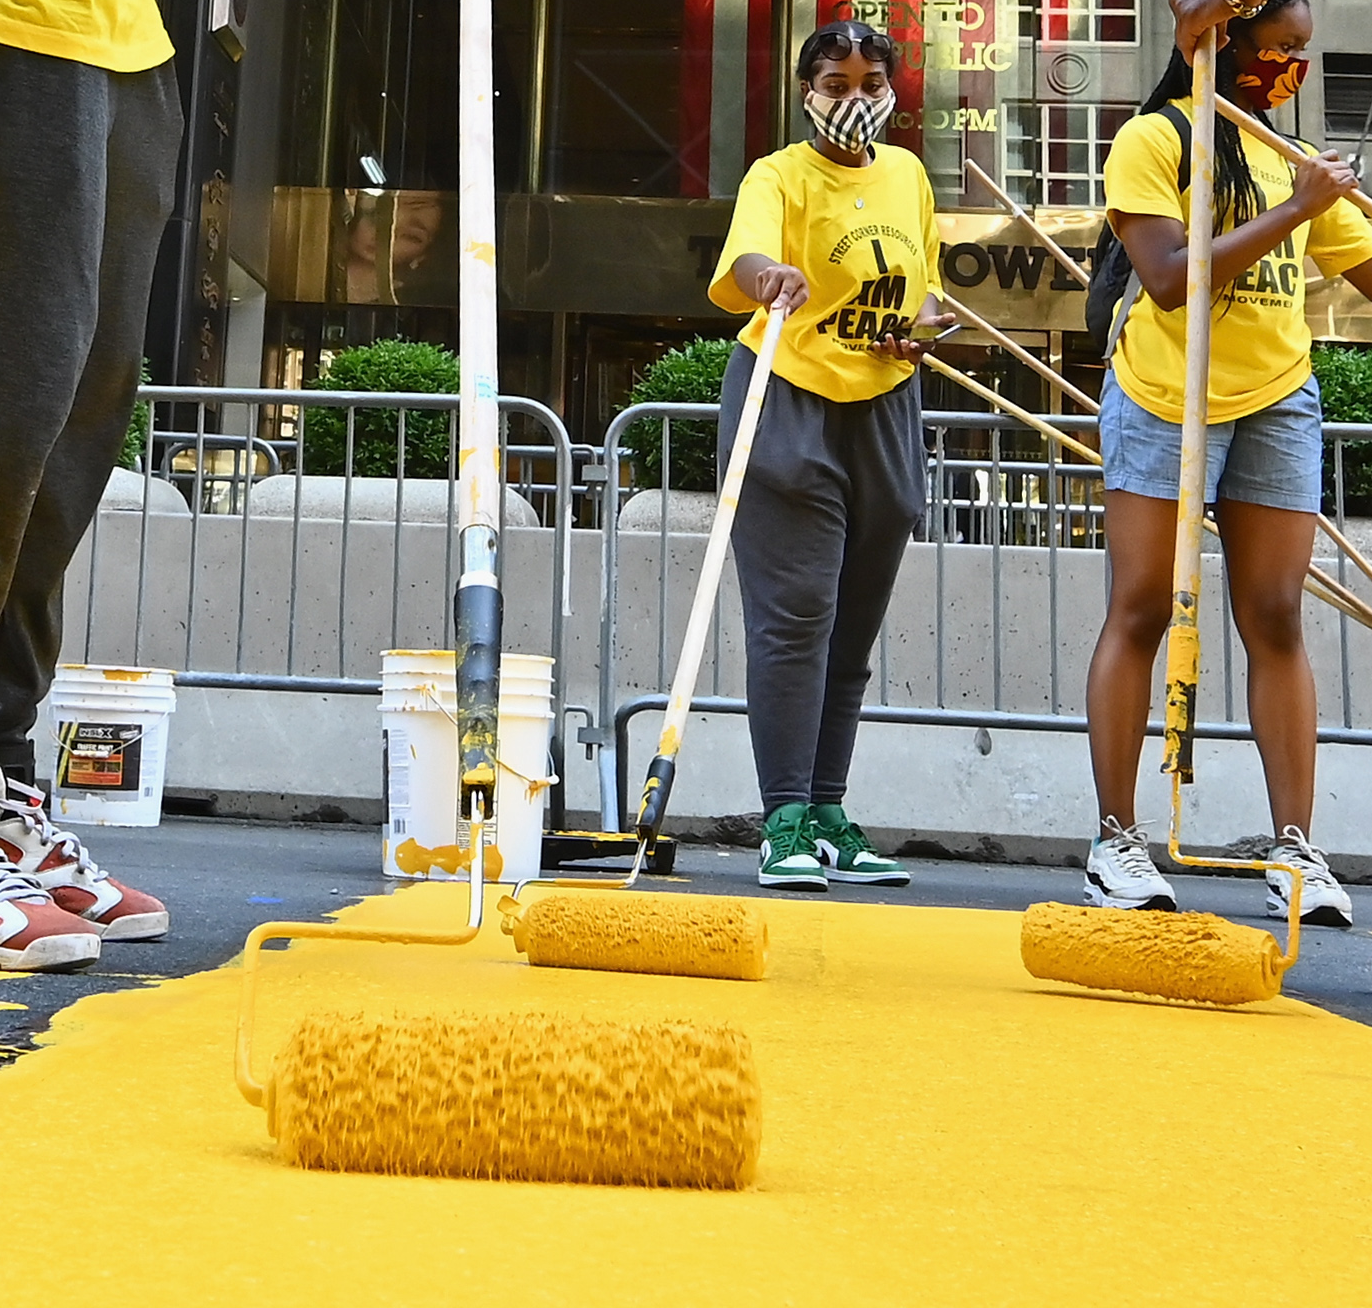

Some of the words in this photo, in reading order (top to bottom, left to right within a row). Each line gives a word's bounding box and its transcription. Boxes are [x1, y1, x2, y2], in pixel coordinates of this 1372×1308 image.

[832, 0, 925, 30] OPEN
[933, 1, 985, 31] TO
[951, 108, 997, 132] PM
[828, 235, 853, 265] STREET
[850, 225, 879, 241] CORNER
[881, 225, 917, 256] RESOURCES
[870, 239, 888, 274] I
[845, 275, 906, 311] AM
[1236, 259, 1299, 297] EAC
